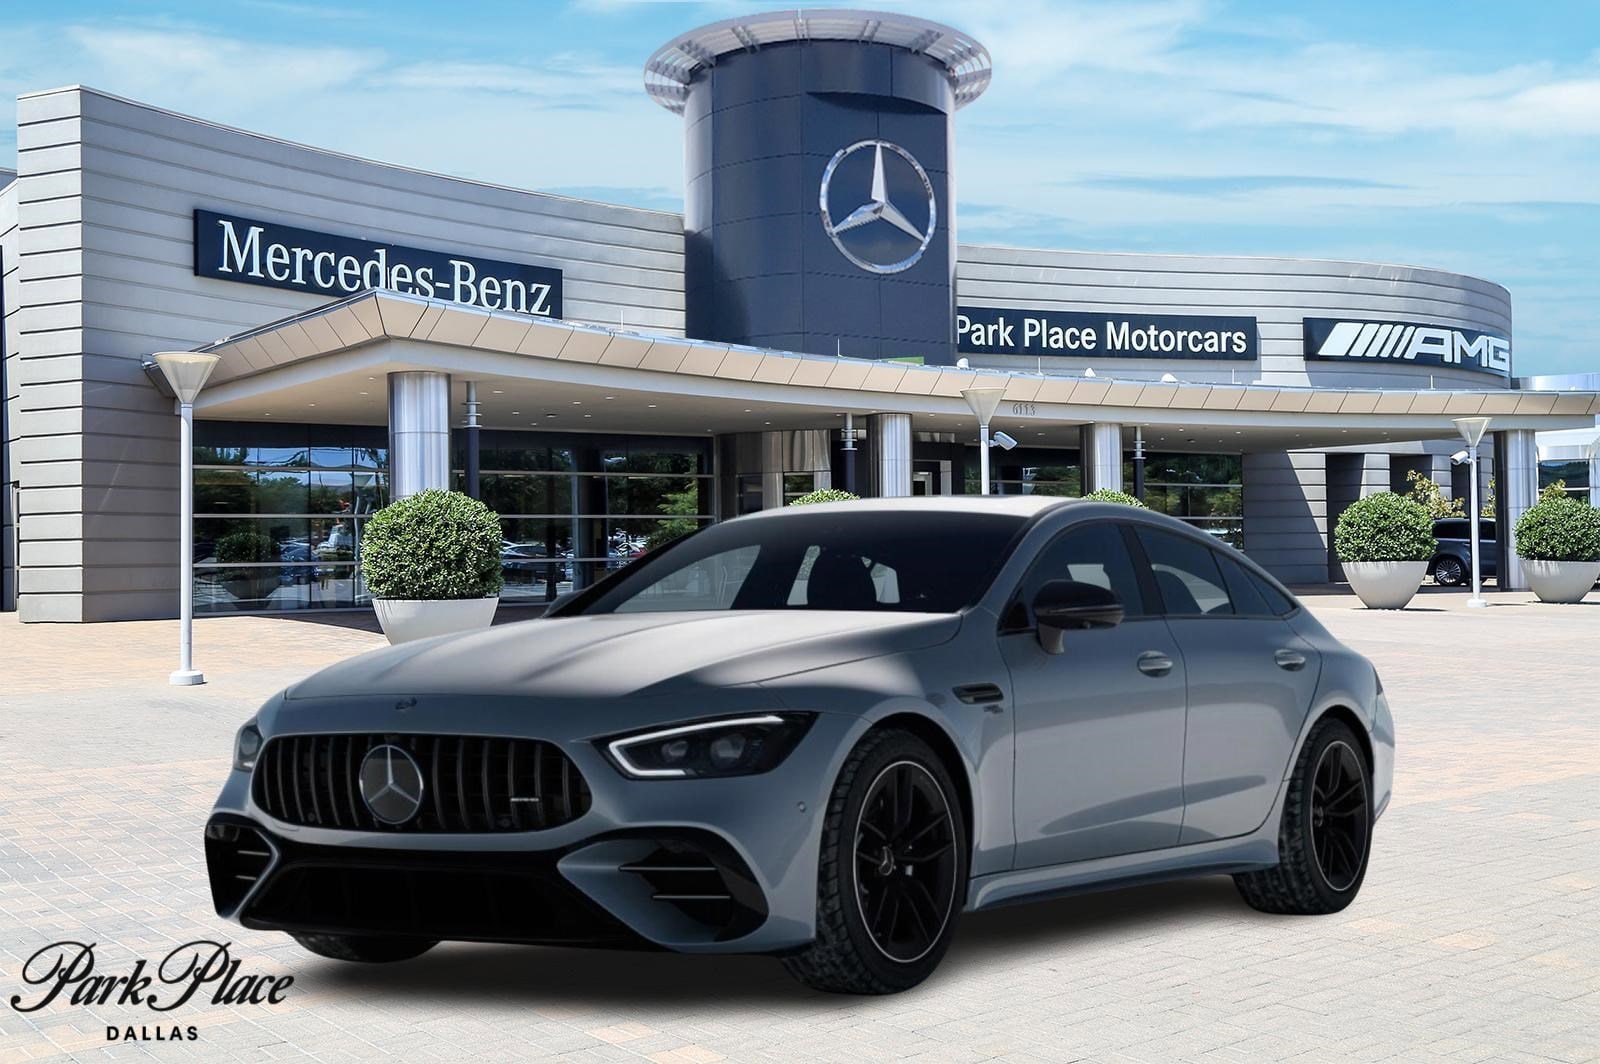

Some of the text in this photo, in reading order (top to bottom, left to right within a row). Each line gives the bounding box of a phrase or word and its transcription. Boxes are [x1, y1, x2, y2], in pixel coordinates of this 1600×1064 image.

[218, 220, 551, 316] Mercedes-Benz
[957, 315, 1247, 353] Park Place Motorcars
[1403, 327, 1510, 372] AMG
